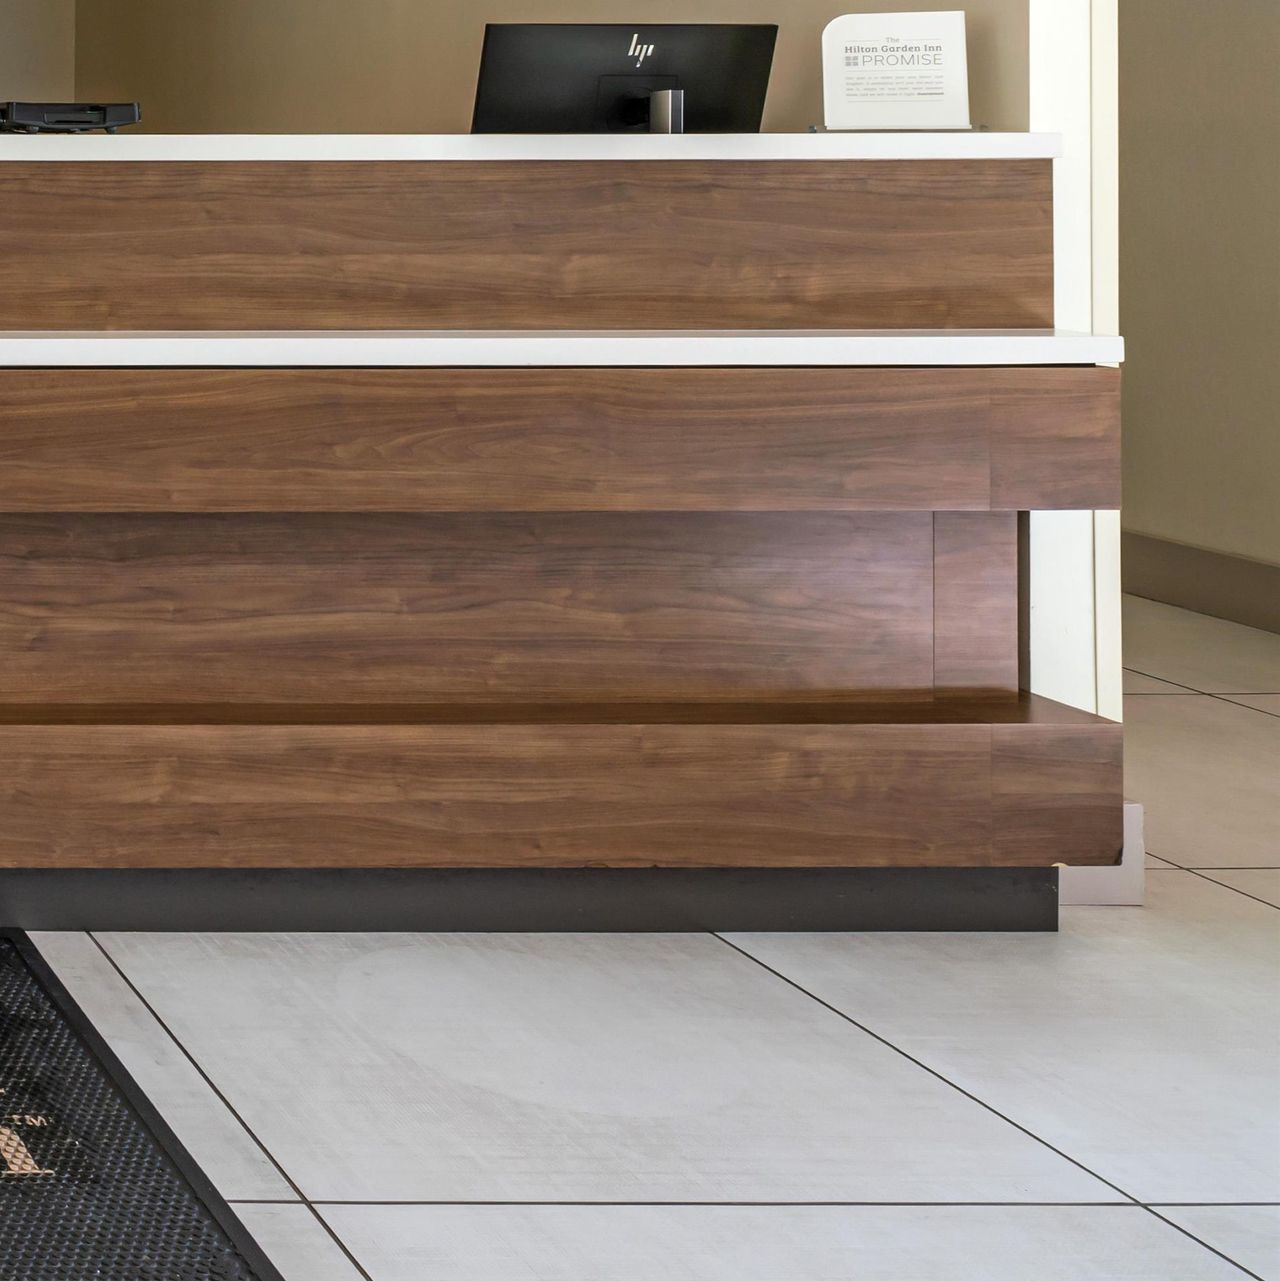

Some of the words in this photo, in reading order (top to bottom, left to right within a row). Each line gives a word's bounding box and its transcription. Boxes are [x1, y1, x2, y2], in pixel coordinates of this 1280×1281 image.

[627, 33, 654, 68] hp
[844, 45, 878, 53] Hilton
[881, 44, 921, 53] Garden
[924, 44, 942, 52] Inn
[862, 53, 943, 67] PROMISE
